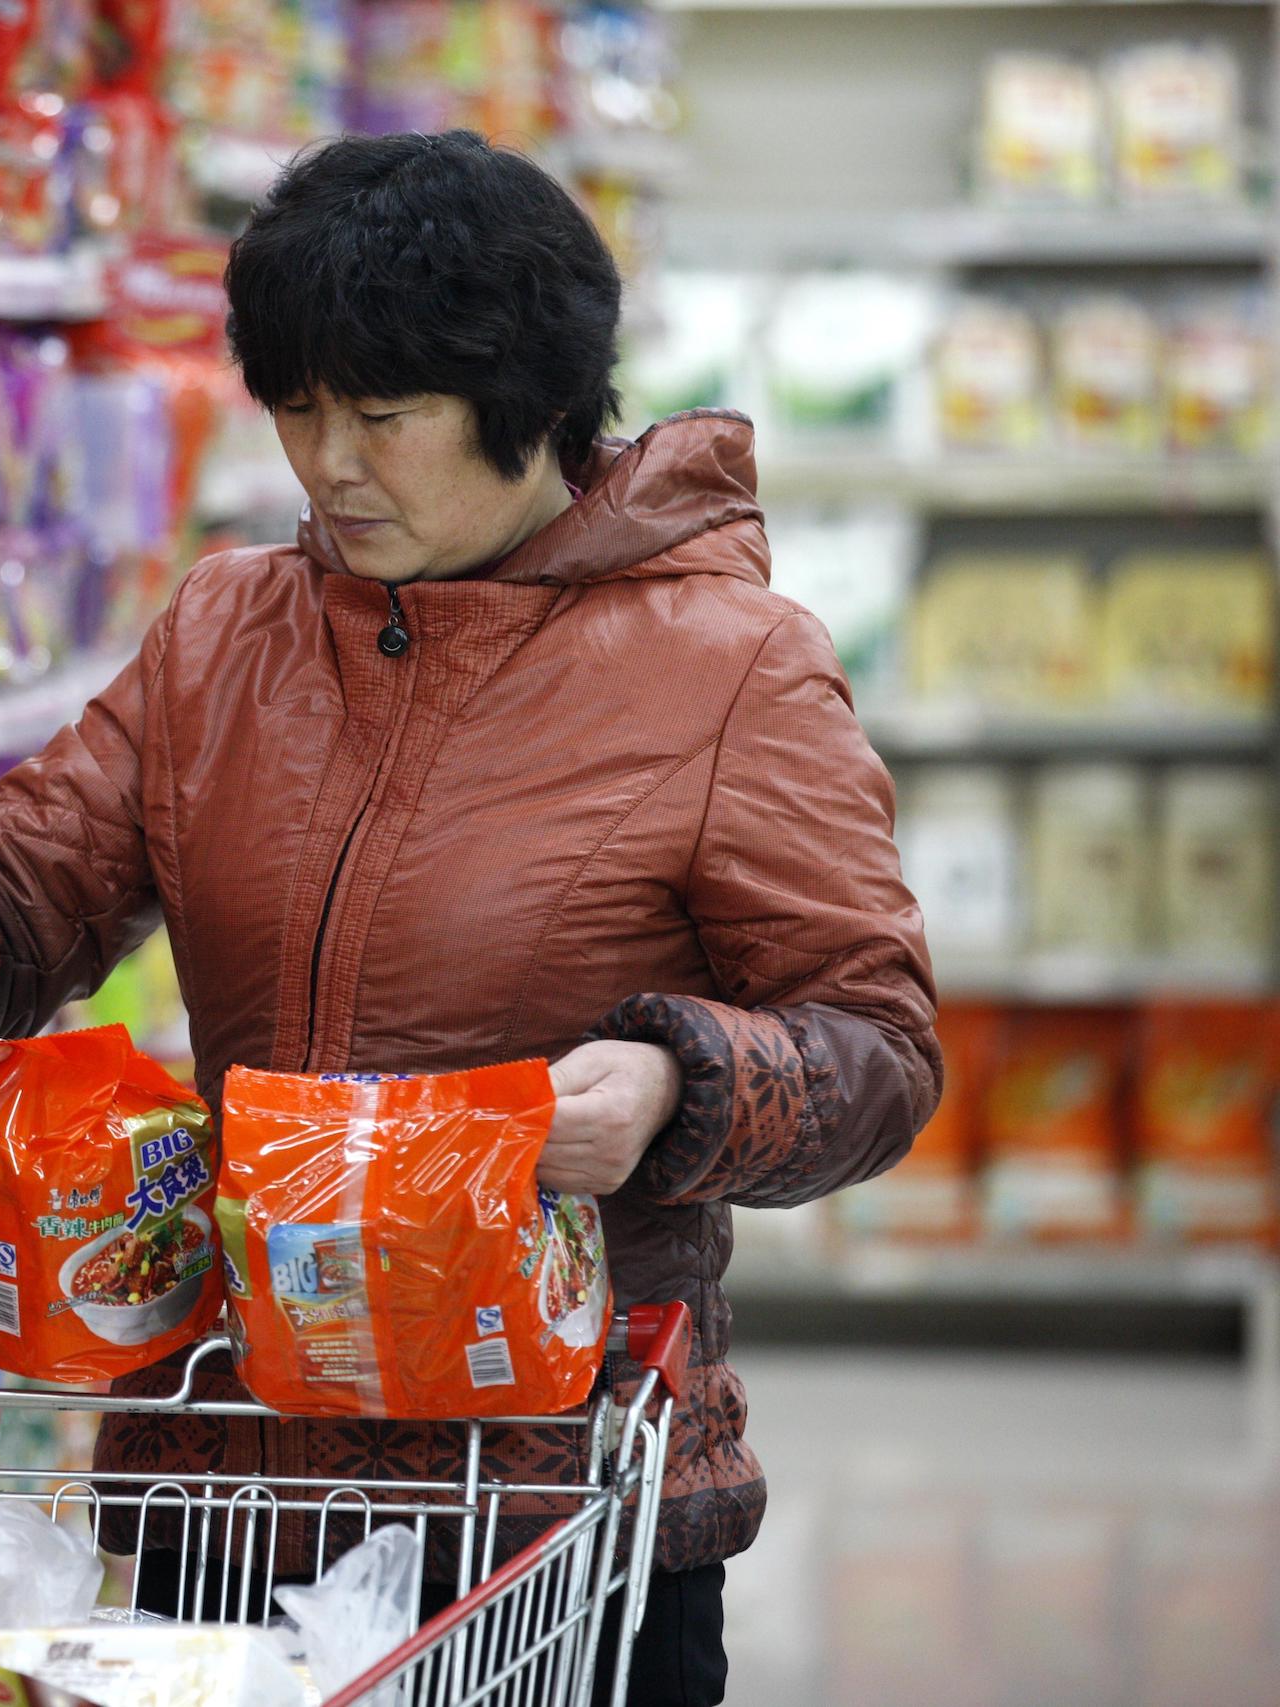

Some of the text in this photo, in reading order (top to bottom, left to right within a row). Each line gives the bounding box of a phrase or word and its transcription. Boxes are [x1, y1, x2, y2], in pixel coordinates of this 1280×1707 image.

[141, 1128, 194, 1170] BIG
[126, 1152, 208, 1232] 大食袋
[273, 1253, 317, 1293] BIG
